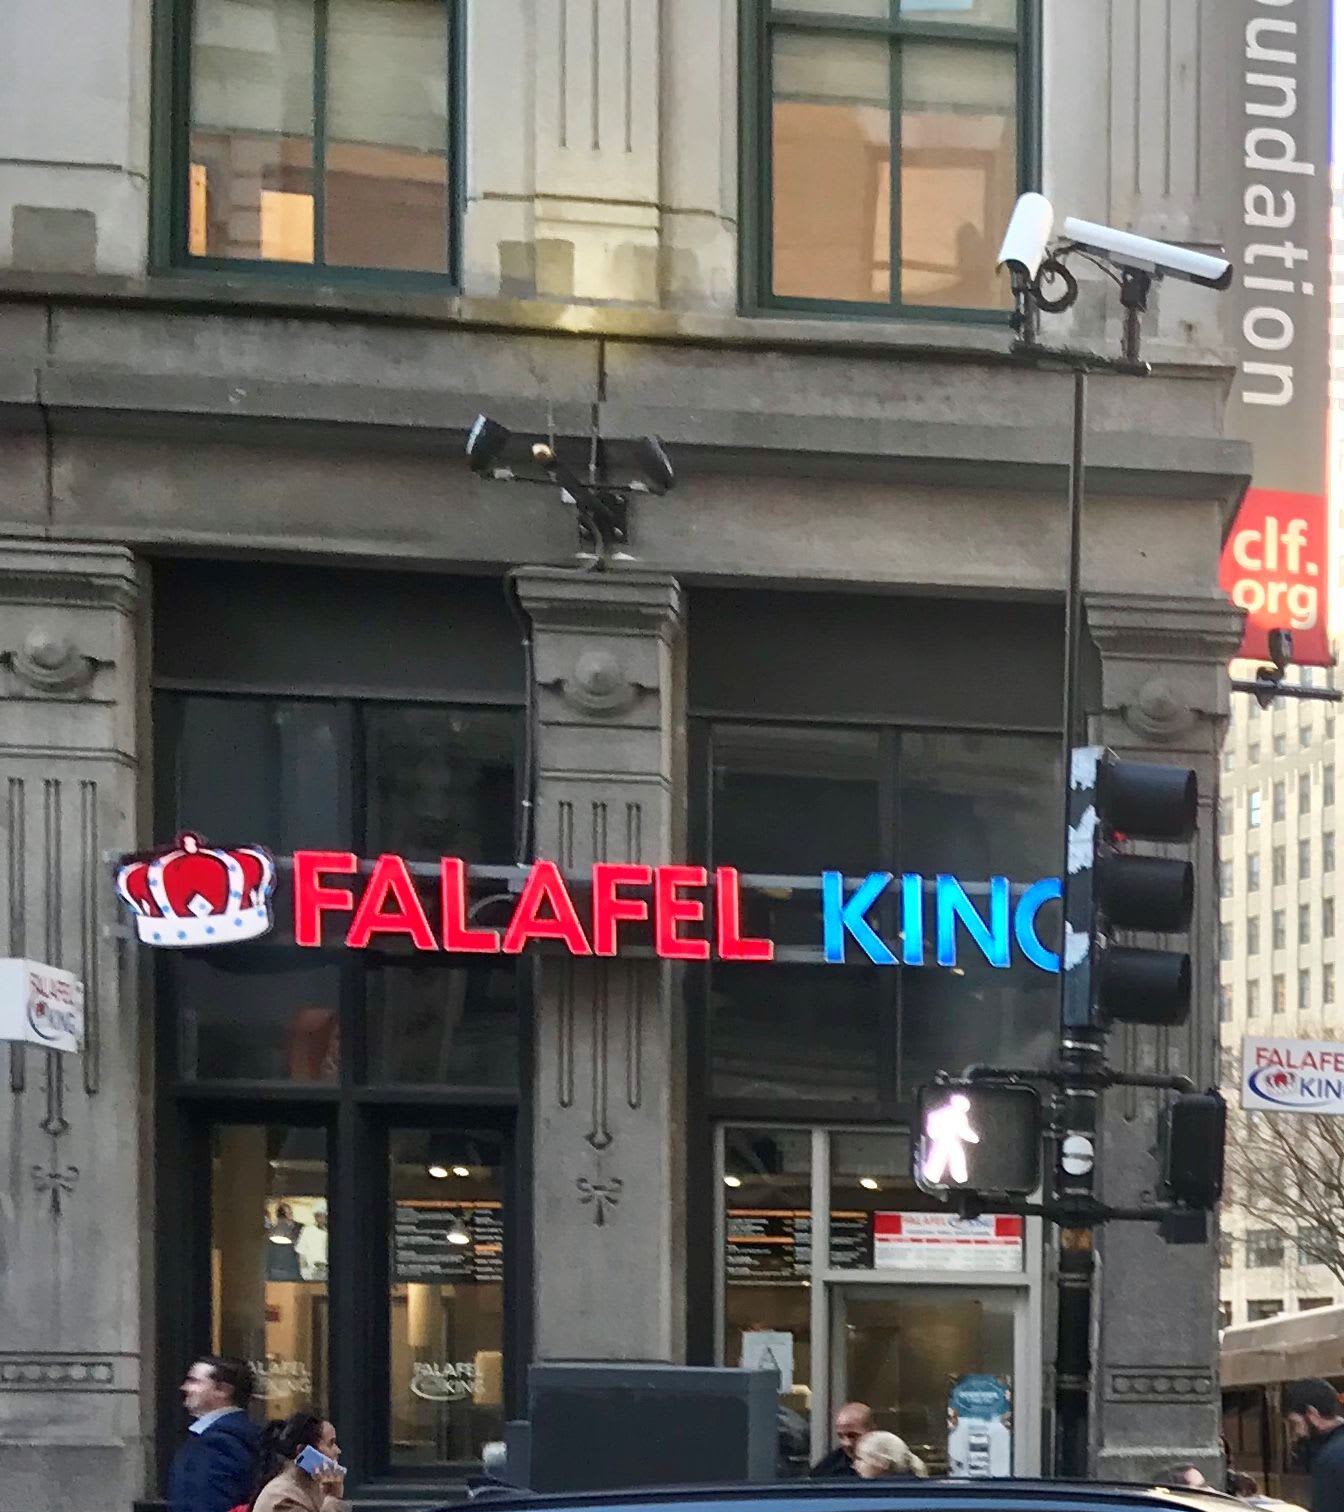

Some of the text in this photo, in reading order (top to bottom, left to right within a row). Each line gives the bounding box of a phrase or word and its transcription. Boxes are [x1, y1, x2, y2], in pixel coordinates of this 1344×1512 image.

[1243, 0, 1314, 406] undation
[1233, 516, 1318, 576] clf.
[1232, 578, 1317, 630] org
[293, 850, 774, 961] FALAFEL
